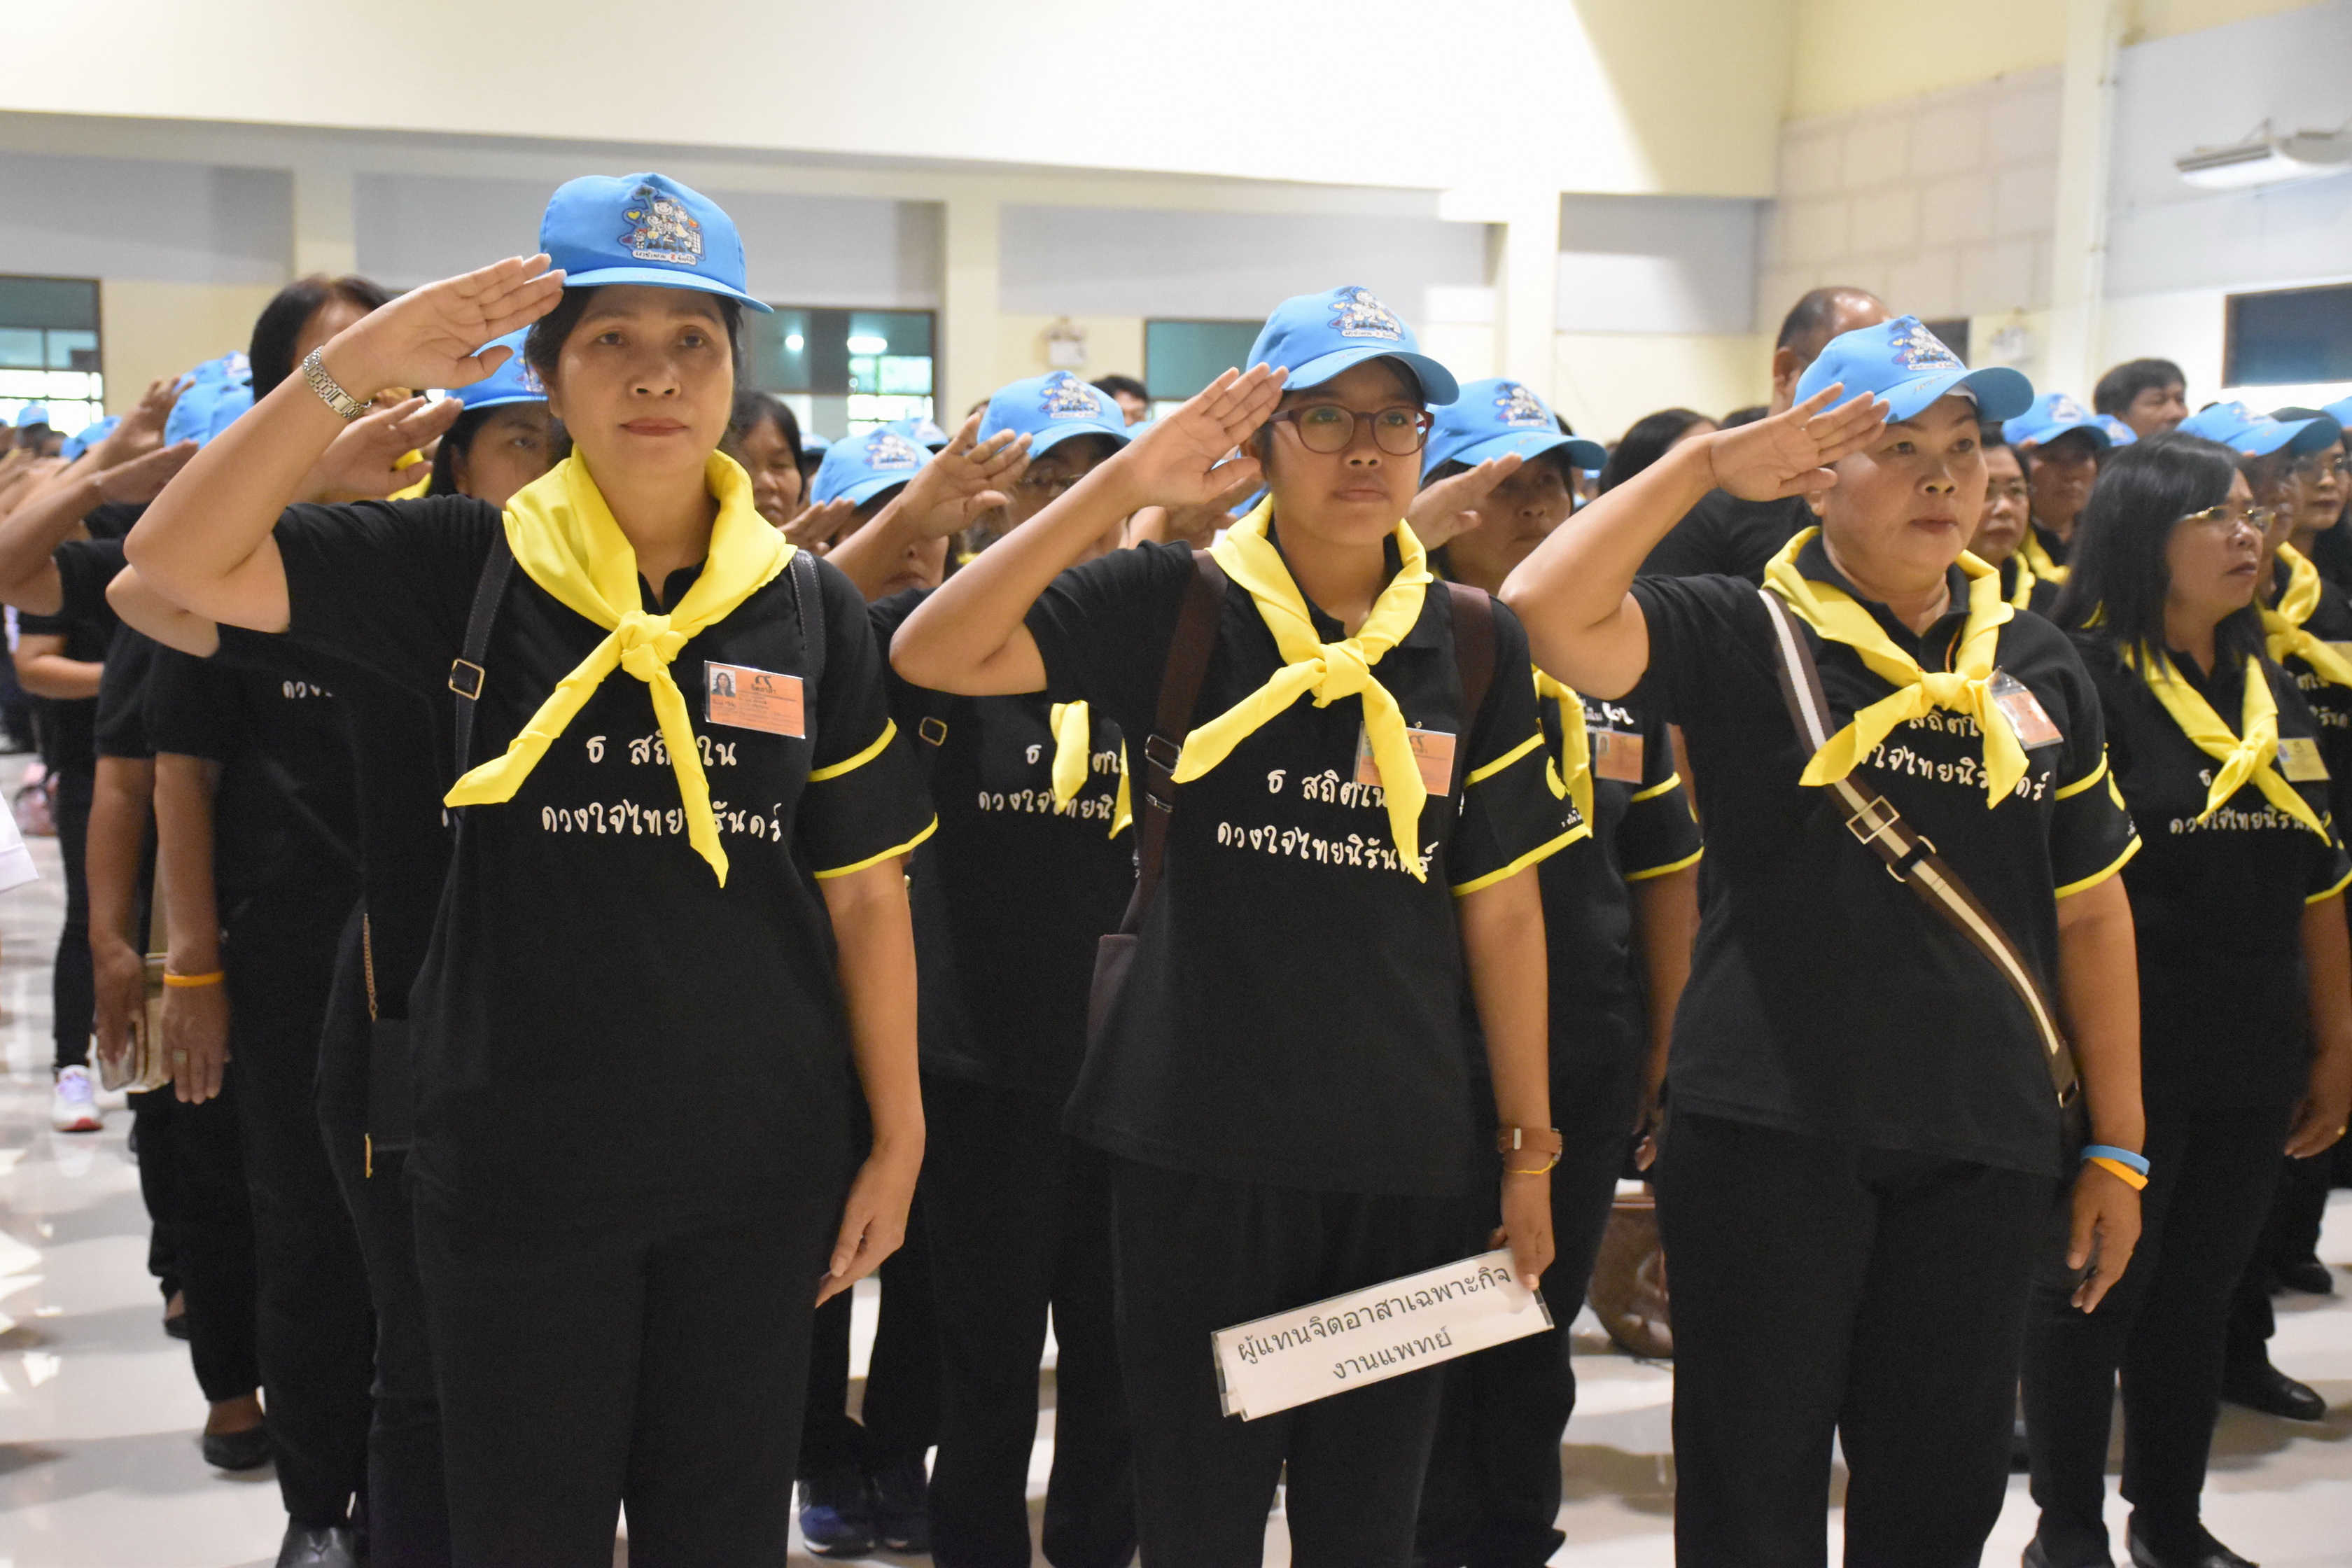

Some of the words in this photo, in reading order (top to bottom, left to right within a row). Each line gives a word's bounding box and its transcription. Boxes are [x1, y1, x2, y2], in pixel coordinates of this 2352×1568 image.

[587, 735, 607, 764] ธ
[629, 729, 737, 766] สถิใน
[1026, 744, 1042, 764] ธ
[1267, 769, 1287, 794] ธ
[542, 799, 782, 842] ดวงใจไทยรันดร์
[1237, 1266, 1512, 1365] ผู้แทนจิตอาสาเฉพาะกิจ
[1332, 1326, 1453, 1379] งานแพทย์
